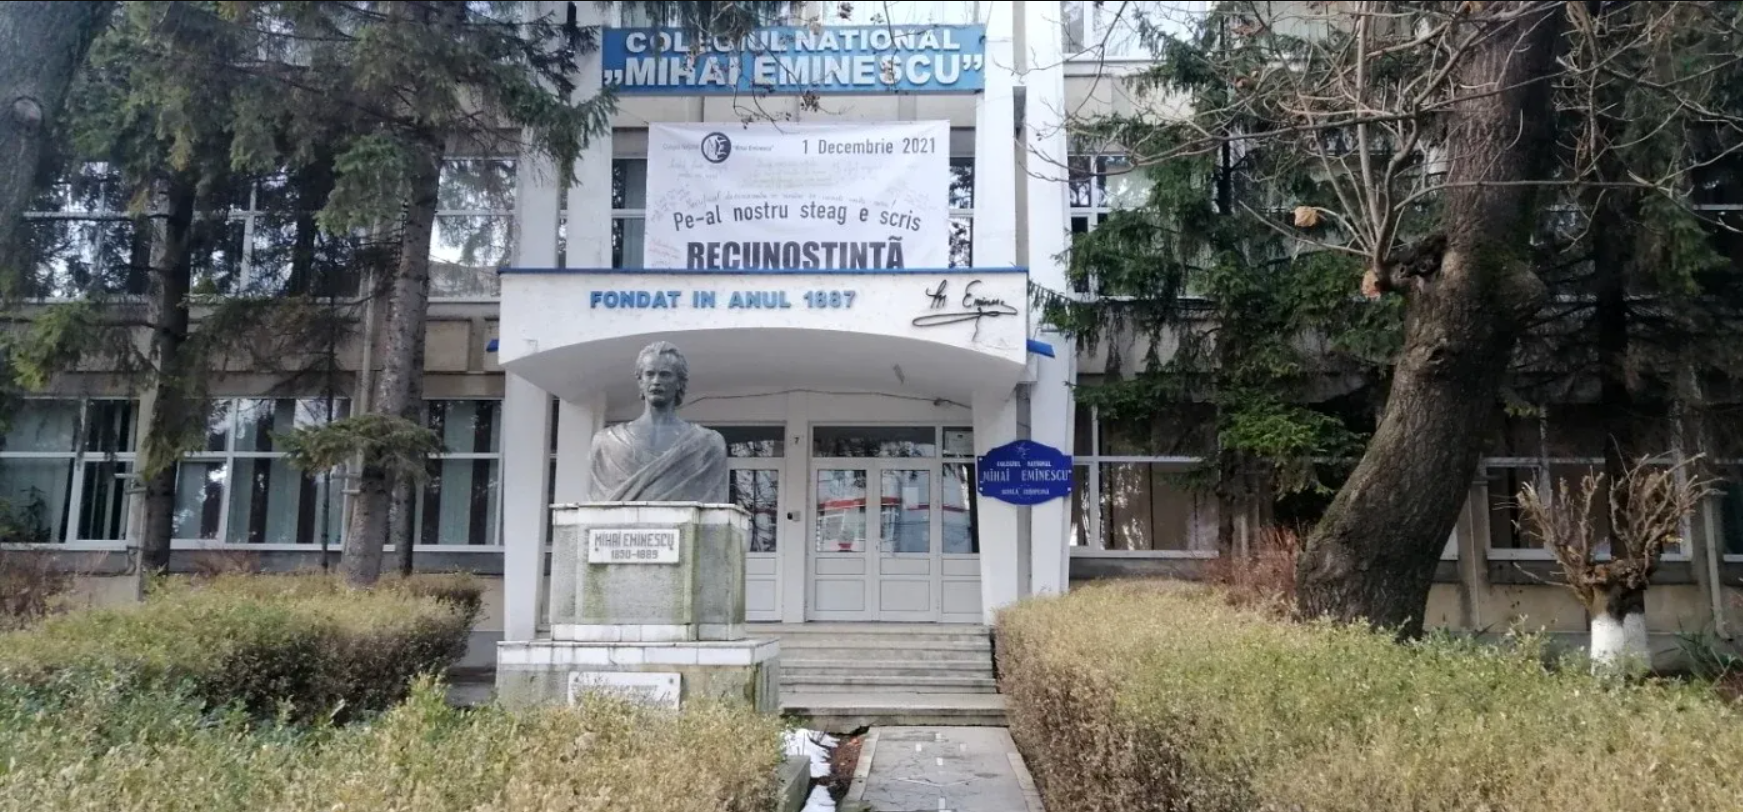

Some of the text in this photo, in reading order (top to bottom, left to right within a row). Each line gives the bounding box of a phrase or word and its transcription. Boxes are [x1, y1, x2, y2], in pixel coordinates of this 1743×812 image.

[794, 29, 961, 51] NATIONAL
[802, 137, 936, 155] 1 Decembrie 2021
[673, 204, 722, 232] Pe-al
[733, 202, 789, 222] nostru
[800, 201, 847, 226] steag
[859, 207, 869, 222] e
[879, 209, 921, 231] scris
[590, 290, 857, 309] FONDAT IN ANUL 1887
[623, 532, 676, 548] EMINESCU
